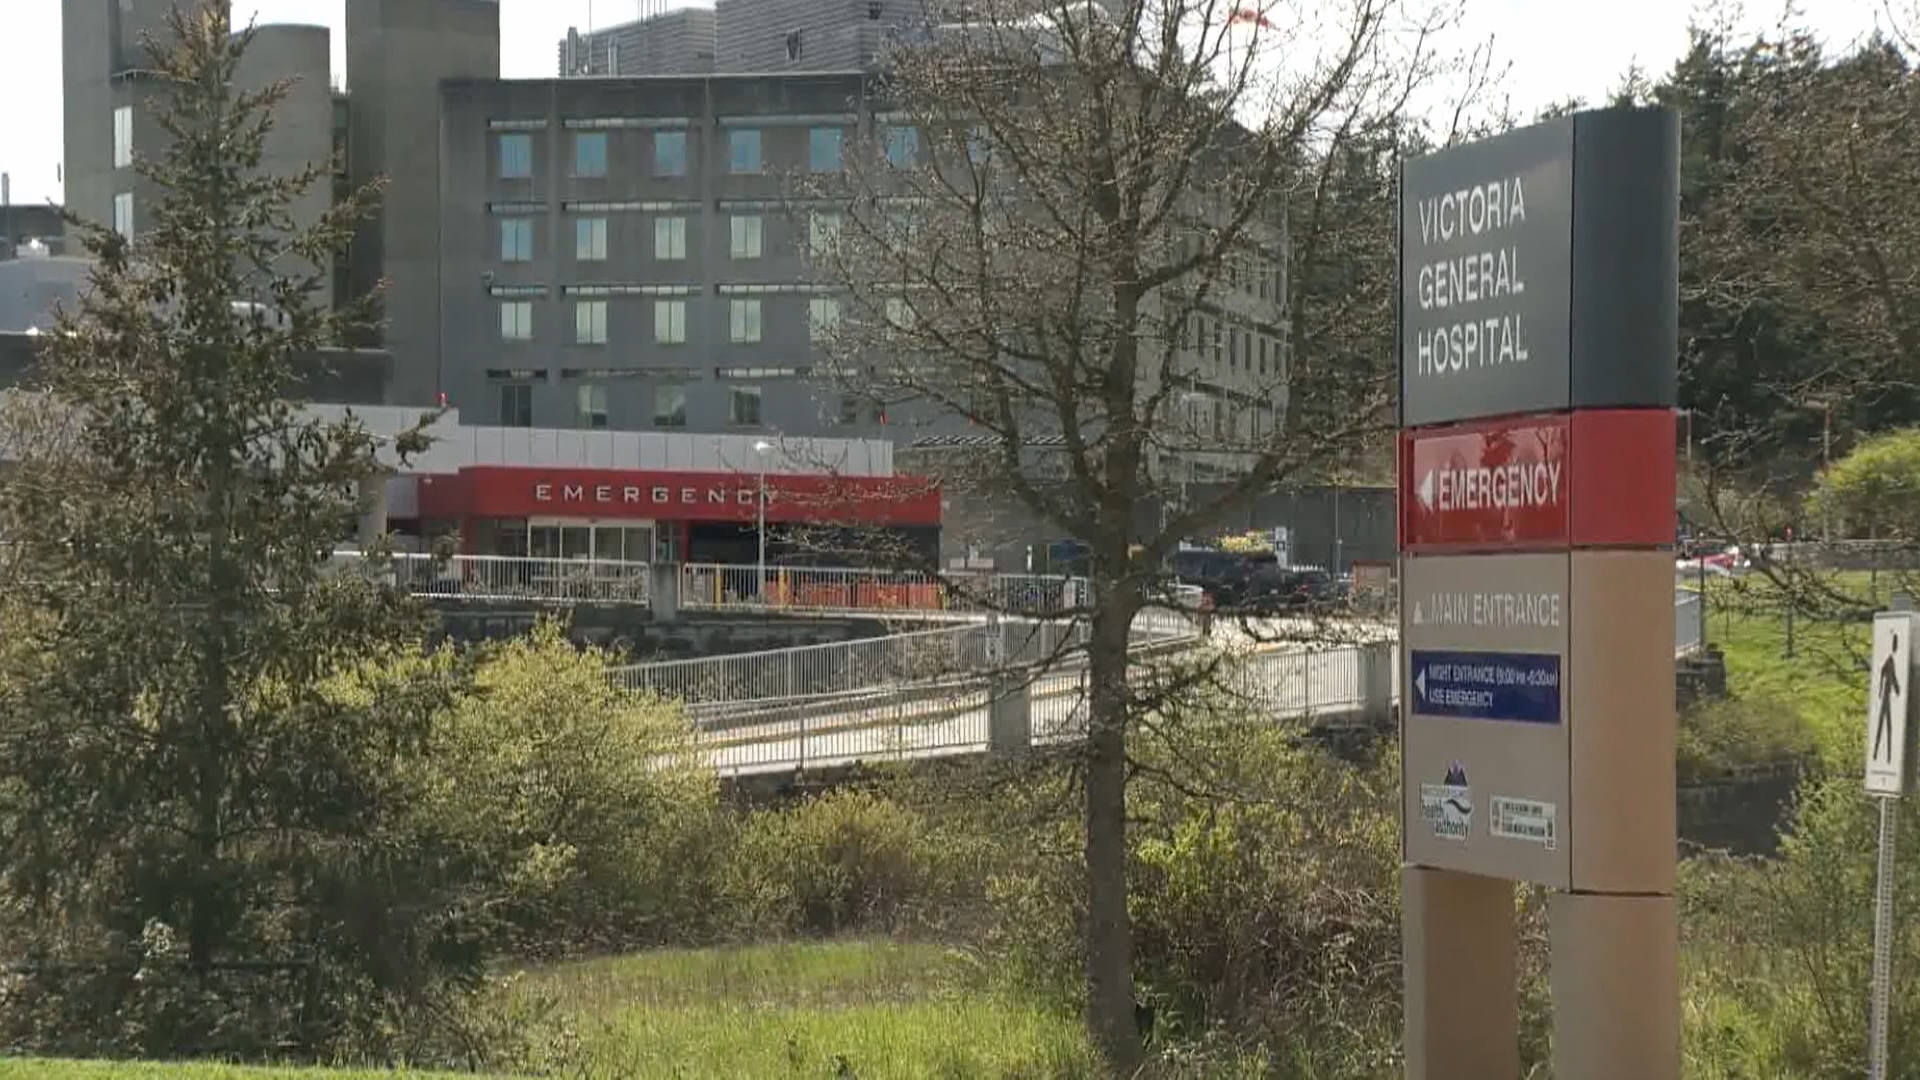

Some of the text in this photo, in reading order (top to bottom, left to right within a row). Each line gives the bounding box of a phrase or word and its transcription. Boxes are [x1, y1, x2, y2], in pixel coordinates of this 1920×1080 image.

[1418, 177, 1525, 245] VICTORIA
[1418, 245, 1524, 310] GENERAL
[1418, 313, 1528, 376] HOSPITAL
[535, 484, 778, 504] EMERGENCY
[1439, 461, 1561, 511] EMERGENCY
[1431, 593, 1560, 627] MAIN ENTRANCE
[1429, 663, 1451, 682] NIGHT
[1453, 664, 1494, 684] ENTRANCE
[1429, 688, 1493, 707] USE EMERGENCY
